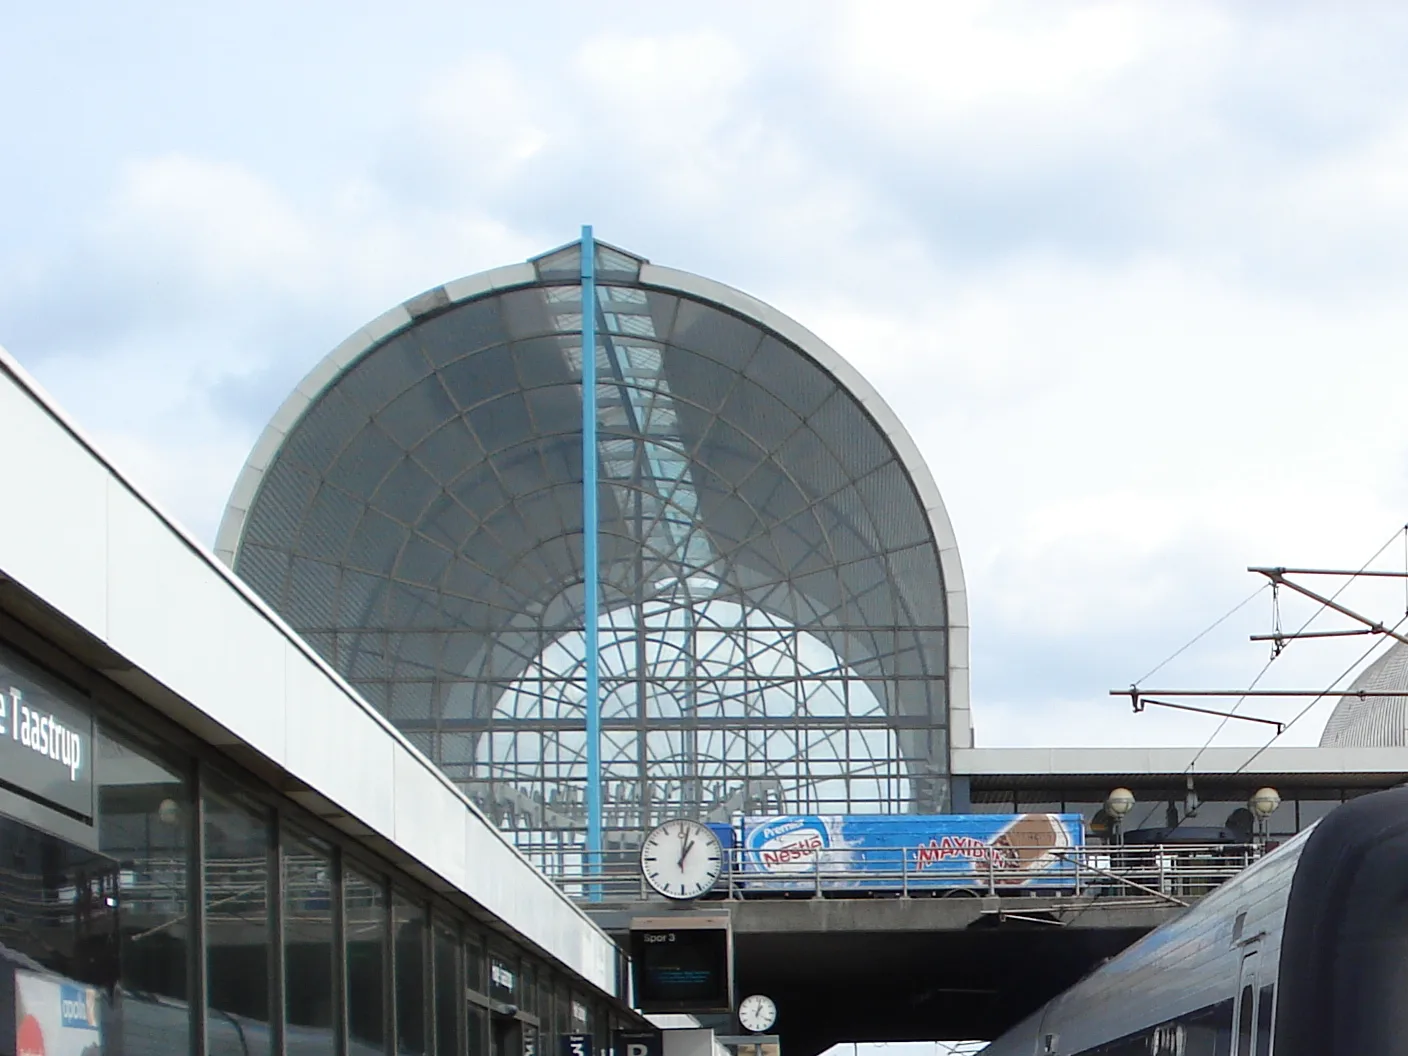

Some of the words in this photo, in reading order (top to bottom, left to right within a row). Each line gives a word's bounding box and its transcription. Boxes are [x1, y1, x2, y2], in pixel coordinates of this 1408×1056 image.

[9, 686, 80, 781] Taastrup
[643, 933, 666, 943] Spor
[668, 933, 676, 942] 3
